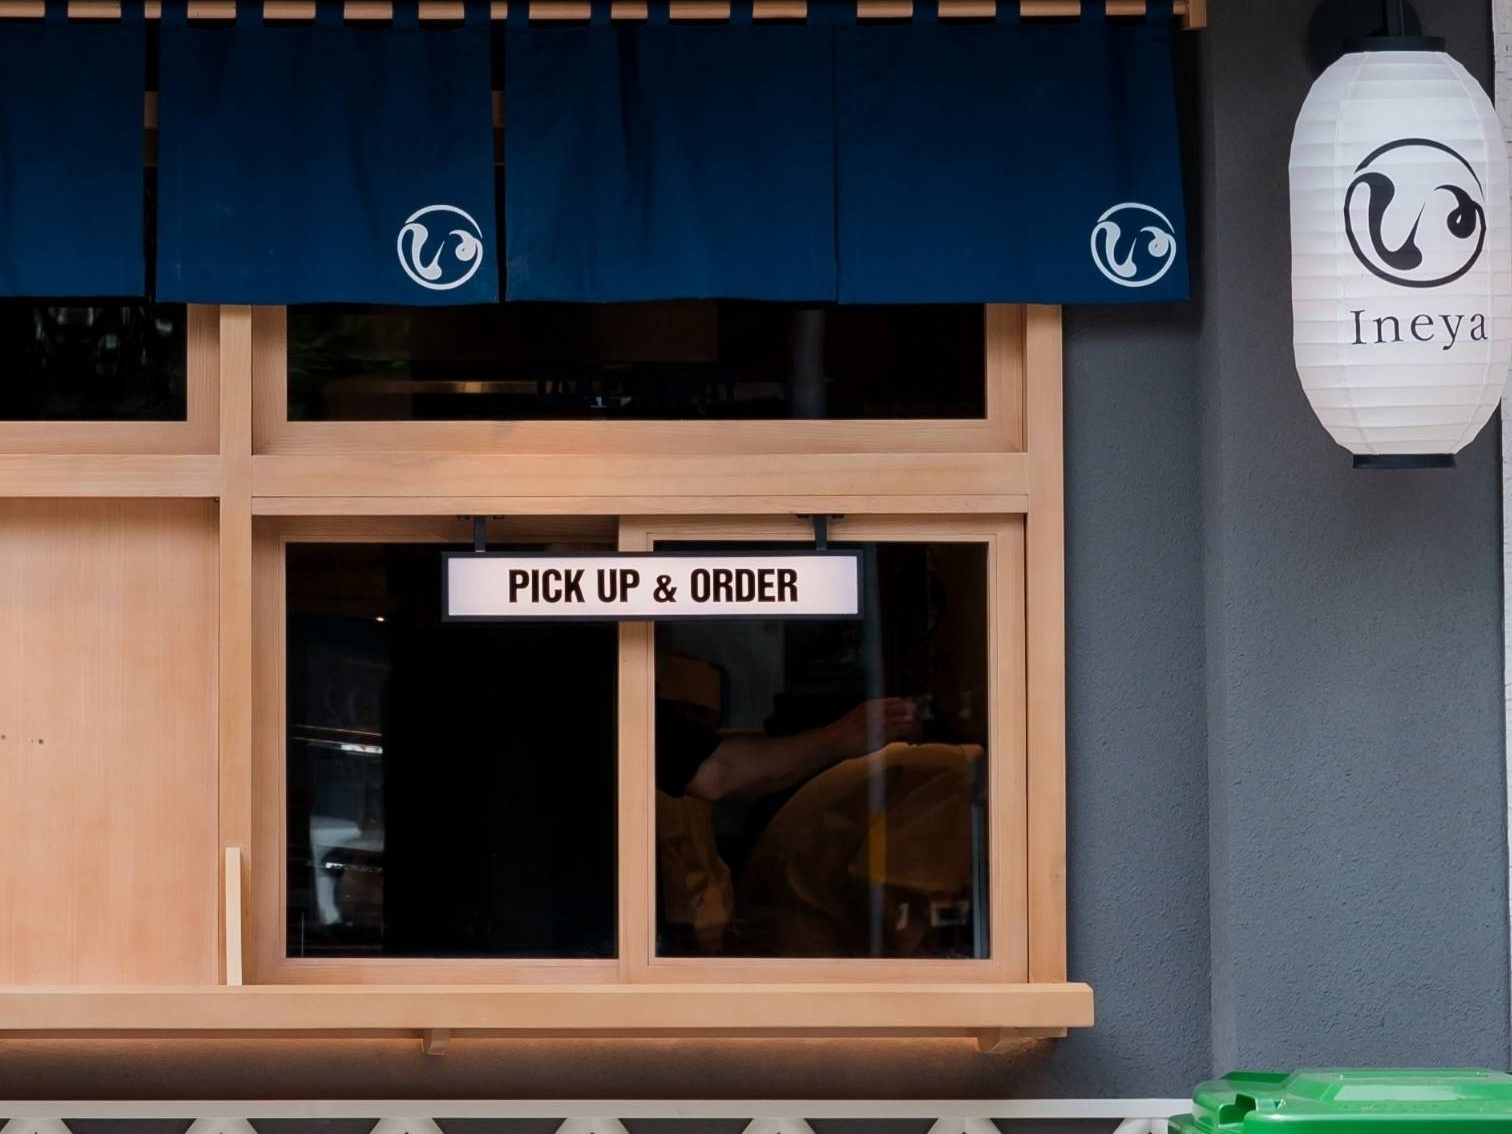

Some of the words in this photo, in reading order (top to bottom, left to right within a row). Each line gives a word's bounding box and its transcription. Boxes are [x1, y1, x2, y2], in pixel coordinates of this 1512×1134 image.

[1349, 309, 1489, 351] Ineya
[509, 569, 586, 603] PICK
[597, 568, 640, 603] UP
[653, 574, 677, 603] &
[690, 568, 799, 603] ORDER
